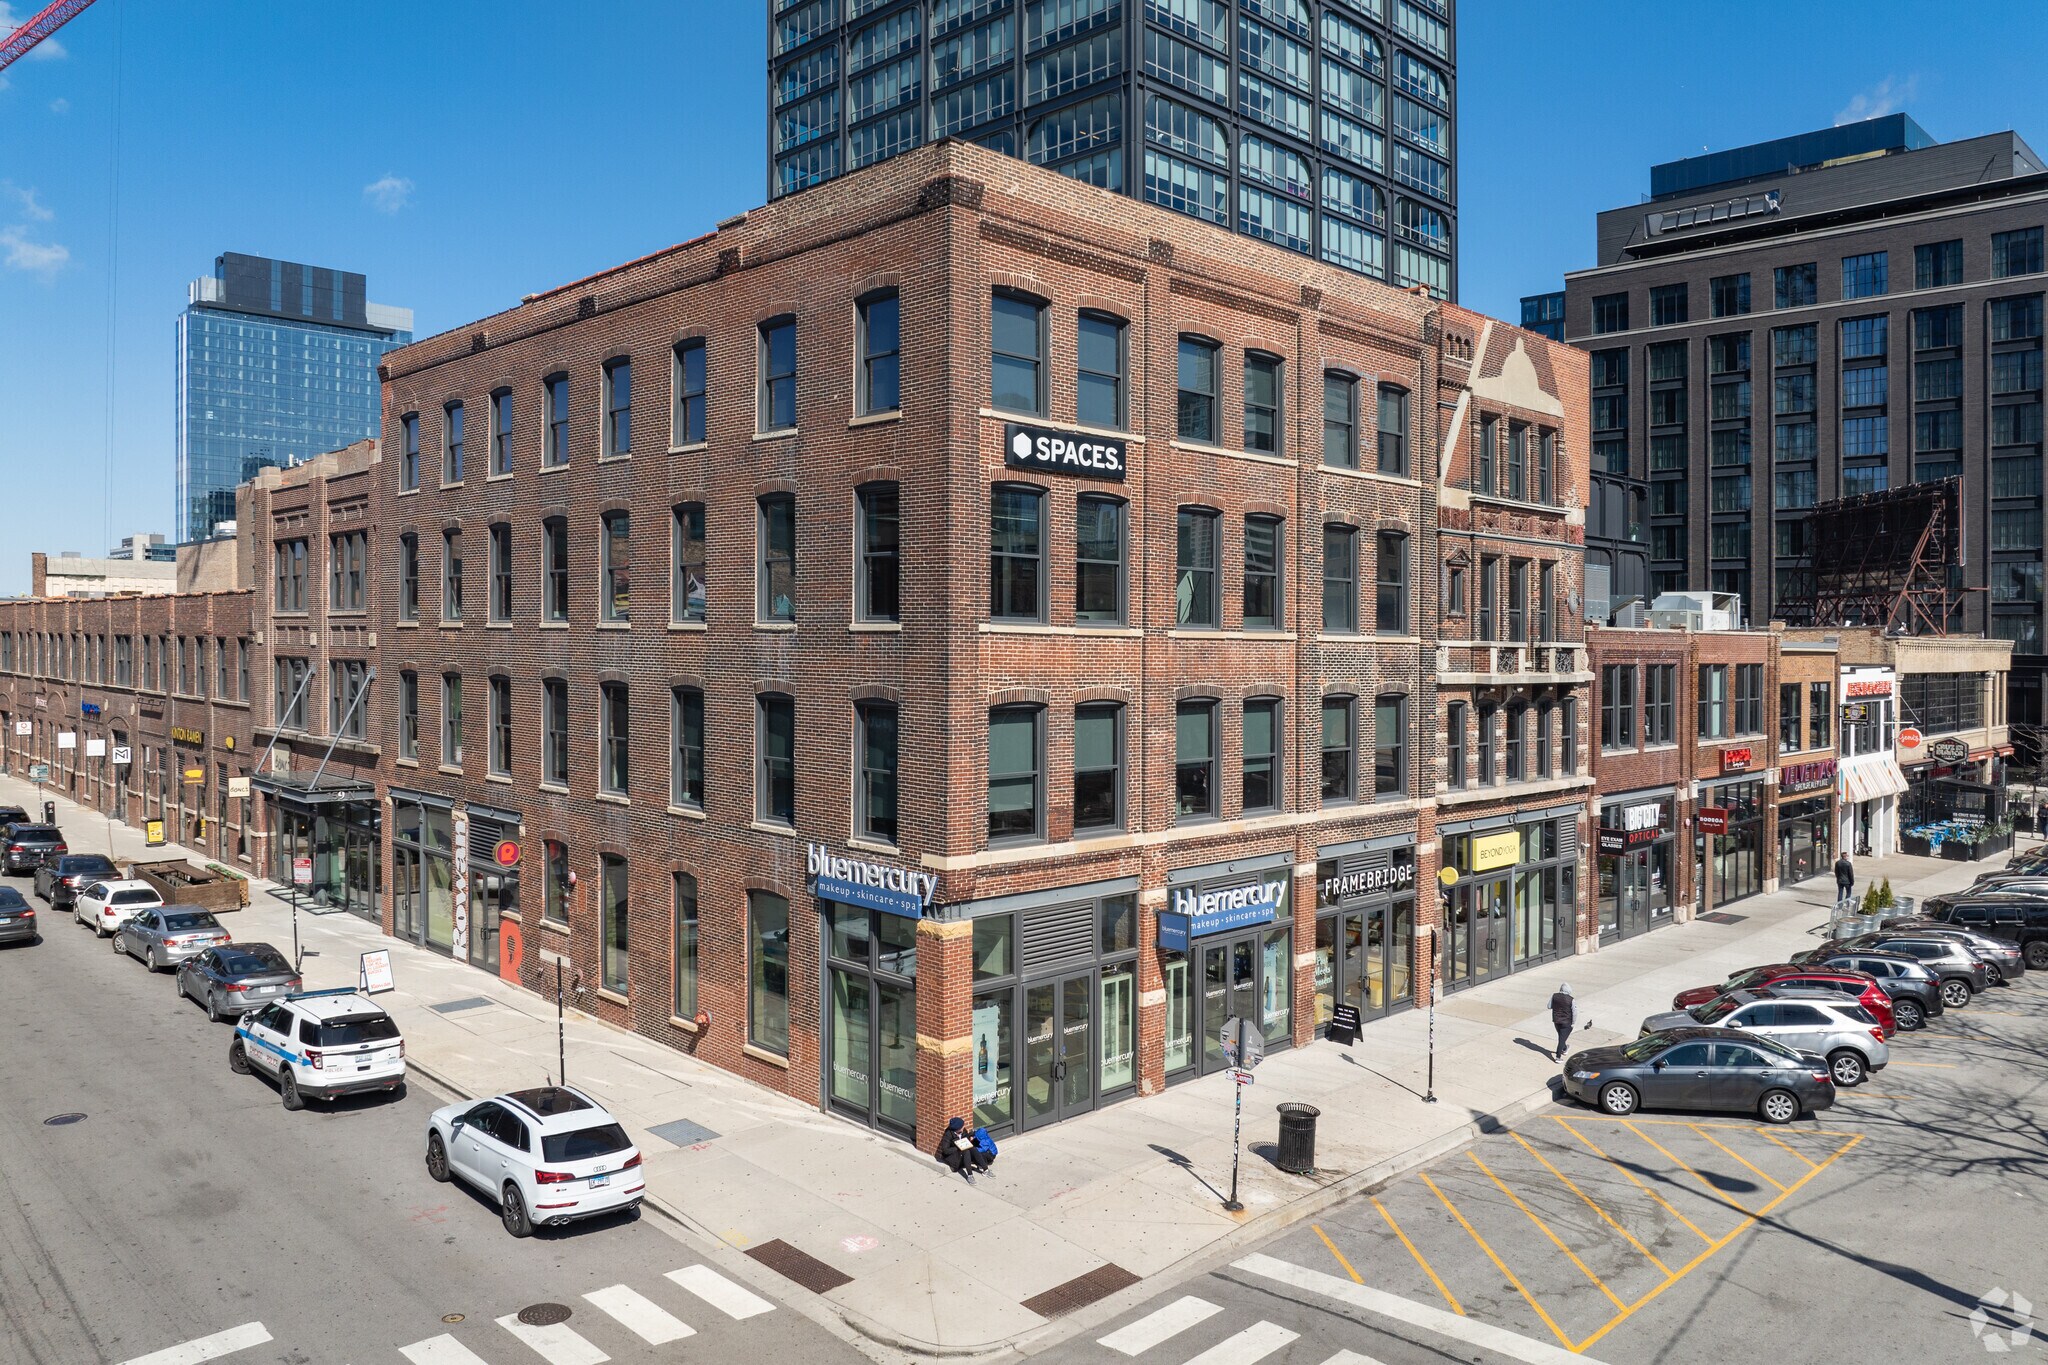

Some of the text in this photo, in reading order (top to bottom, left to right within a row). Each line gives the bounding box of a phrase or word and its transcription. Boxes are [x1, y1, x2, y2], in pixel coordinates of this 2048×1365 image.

[1036, 436, 1123, 471] SPACES.
[1784, 763, 1815, 785] VELVET
[1625, 804, 1660, 832] BIG CITY
[1699, 816, 1724, 824] BODEGA
[1629, 829, 1659, 843] OPTICAL
[808, 843, 939, 906] bluemercury
[1325, 864, 1413, 896] FRAMEBRIDGE
[819, 882, 916, 911] makeup skincare spa
[1174, 880, 1287, 917] bluemercury
[1191, 907, 1274, 930] makeup skincare spa
[1161, 925, 1186, 937] bluemercury
[1315, 976, 1333, 987] resent
[1205, 988, 1226, 998] bluemercury
[1027, 1032, 1053, 1044] bluemercury
[1063, 1023, 1088, 1034] bluemercury
[833, 1060, 870, 1084] bluemercury
